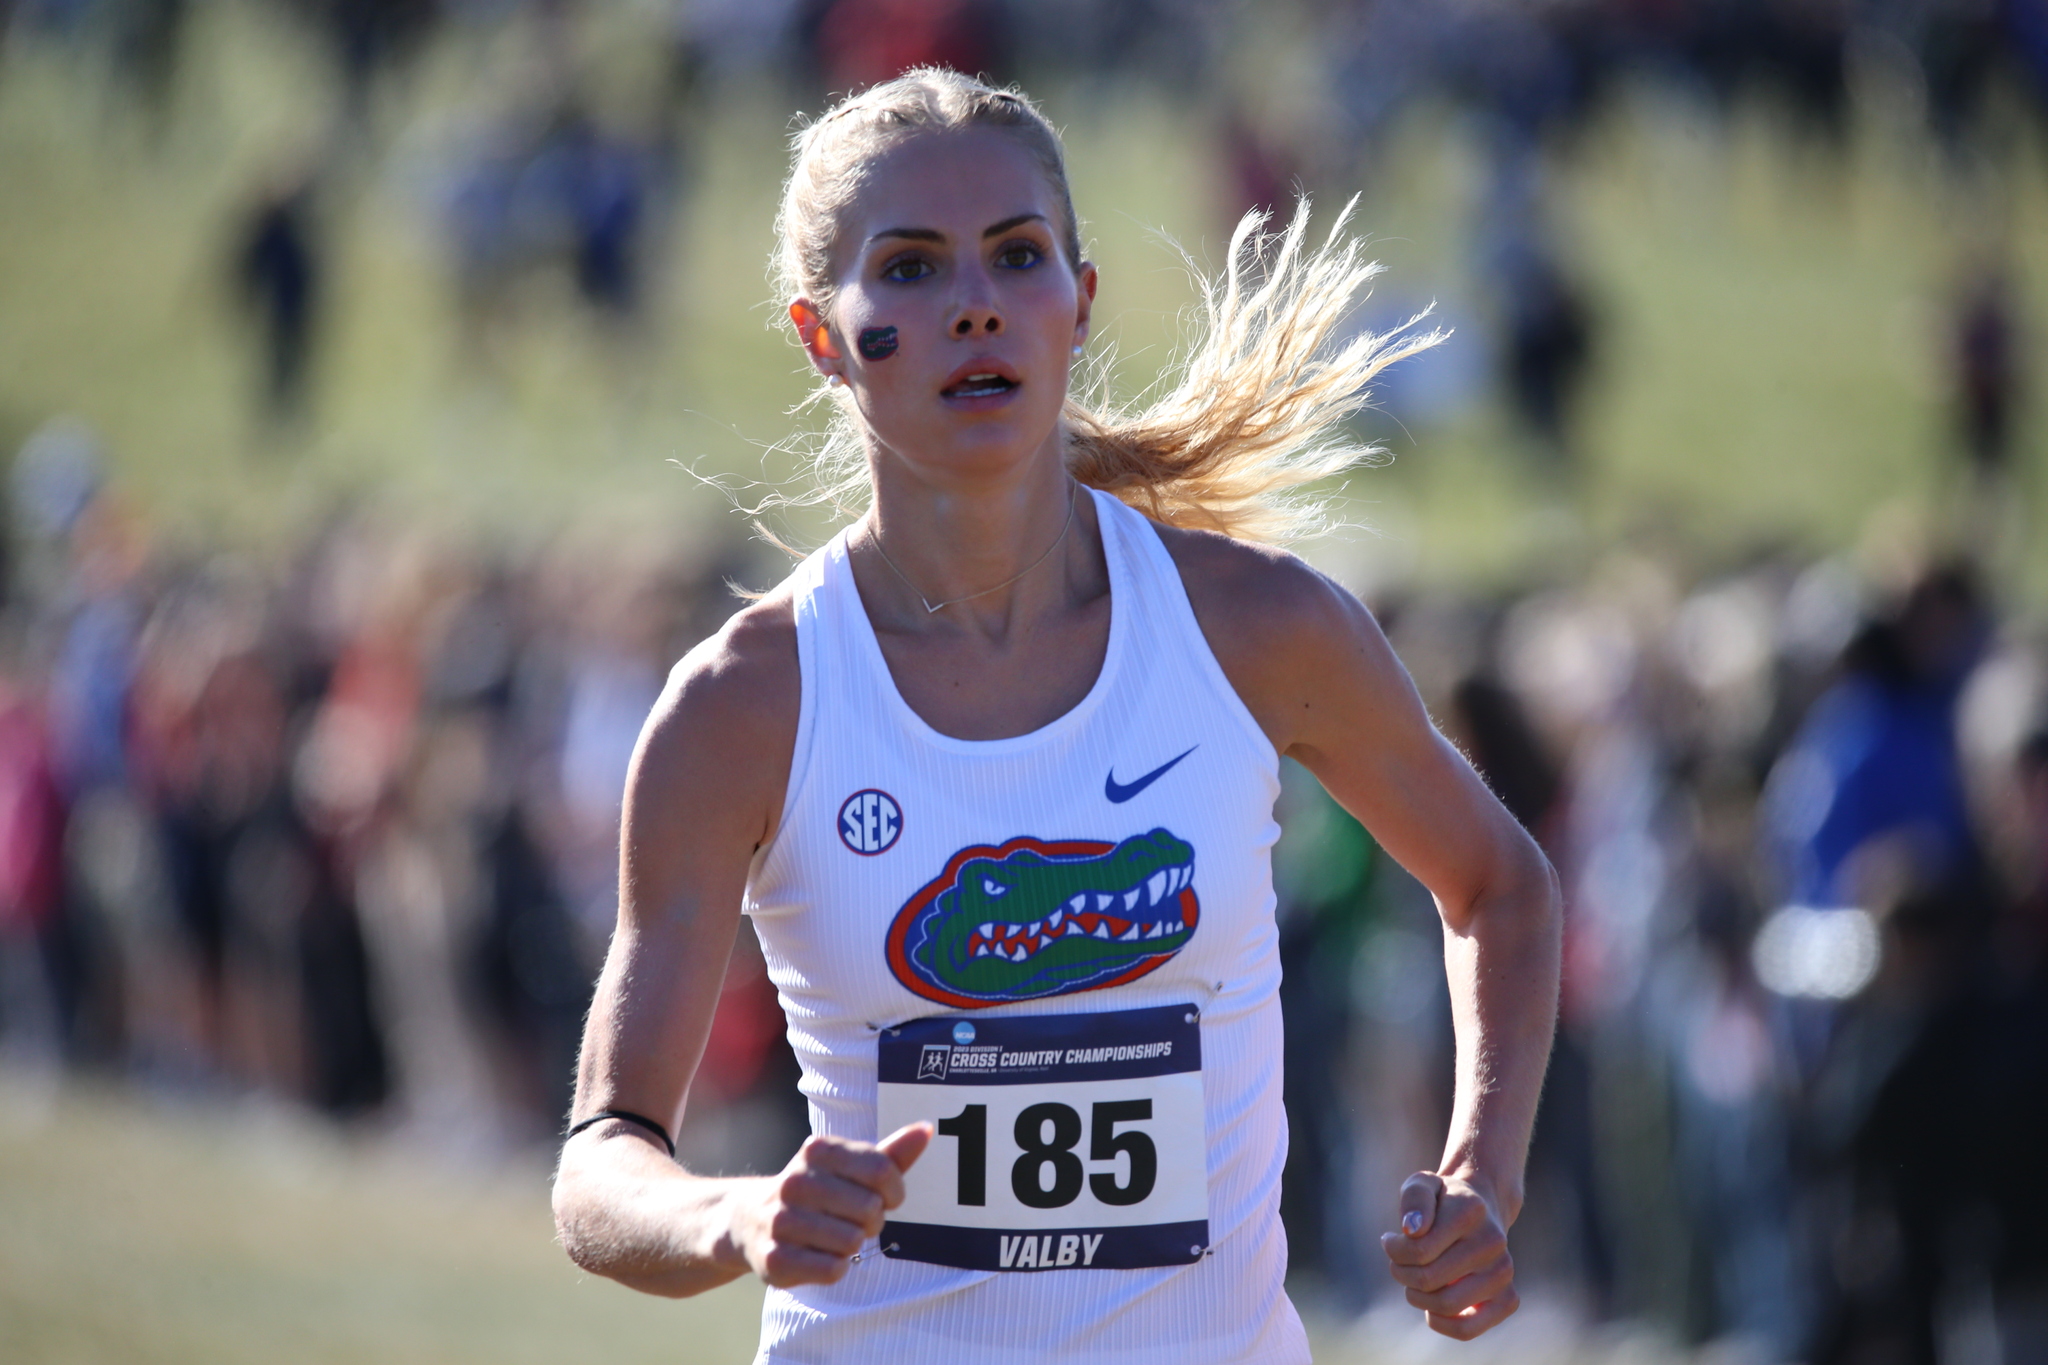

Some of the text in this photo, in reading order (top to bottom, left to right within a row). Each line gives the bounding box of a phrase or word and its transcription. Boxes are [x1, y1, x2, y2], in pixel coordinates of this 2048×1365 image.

[843, 793, 898, 852] SEC
[950, 1041, 1173, 1068] CROSS COUNTRY CHAMPIONSHIPS
[938, 1098, 1158, 1209] 185
[999, 1234, 1104, 1268] VALBY
